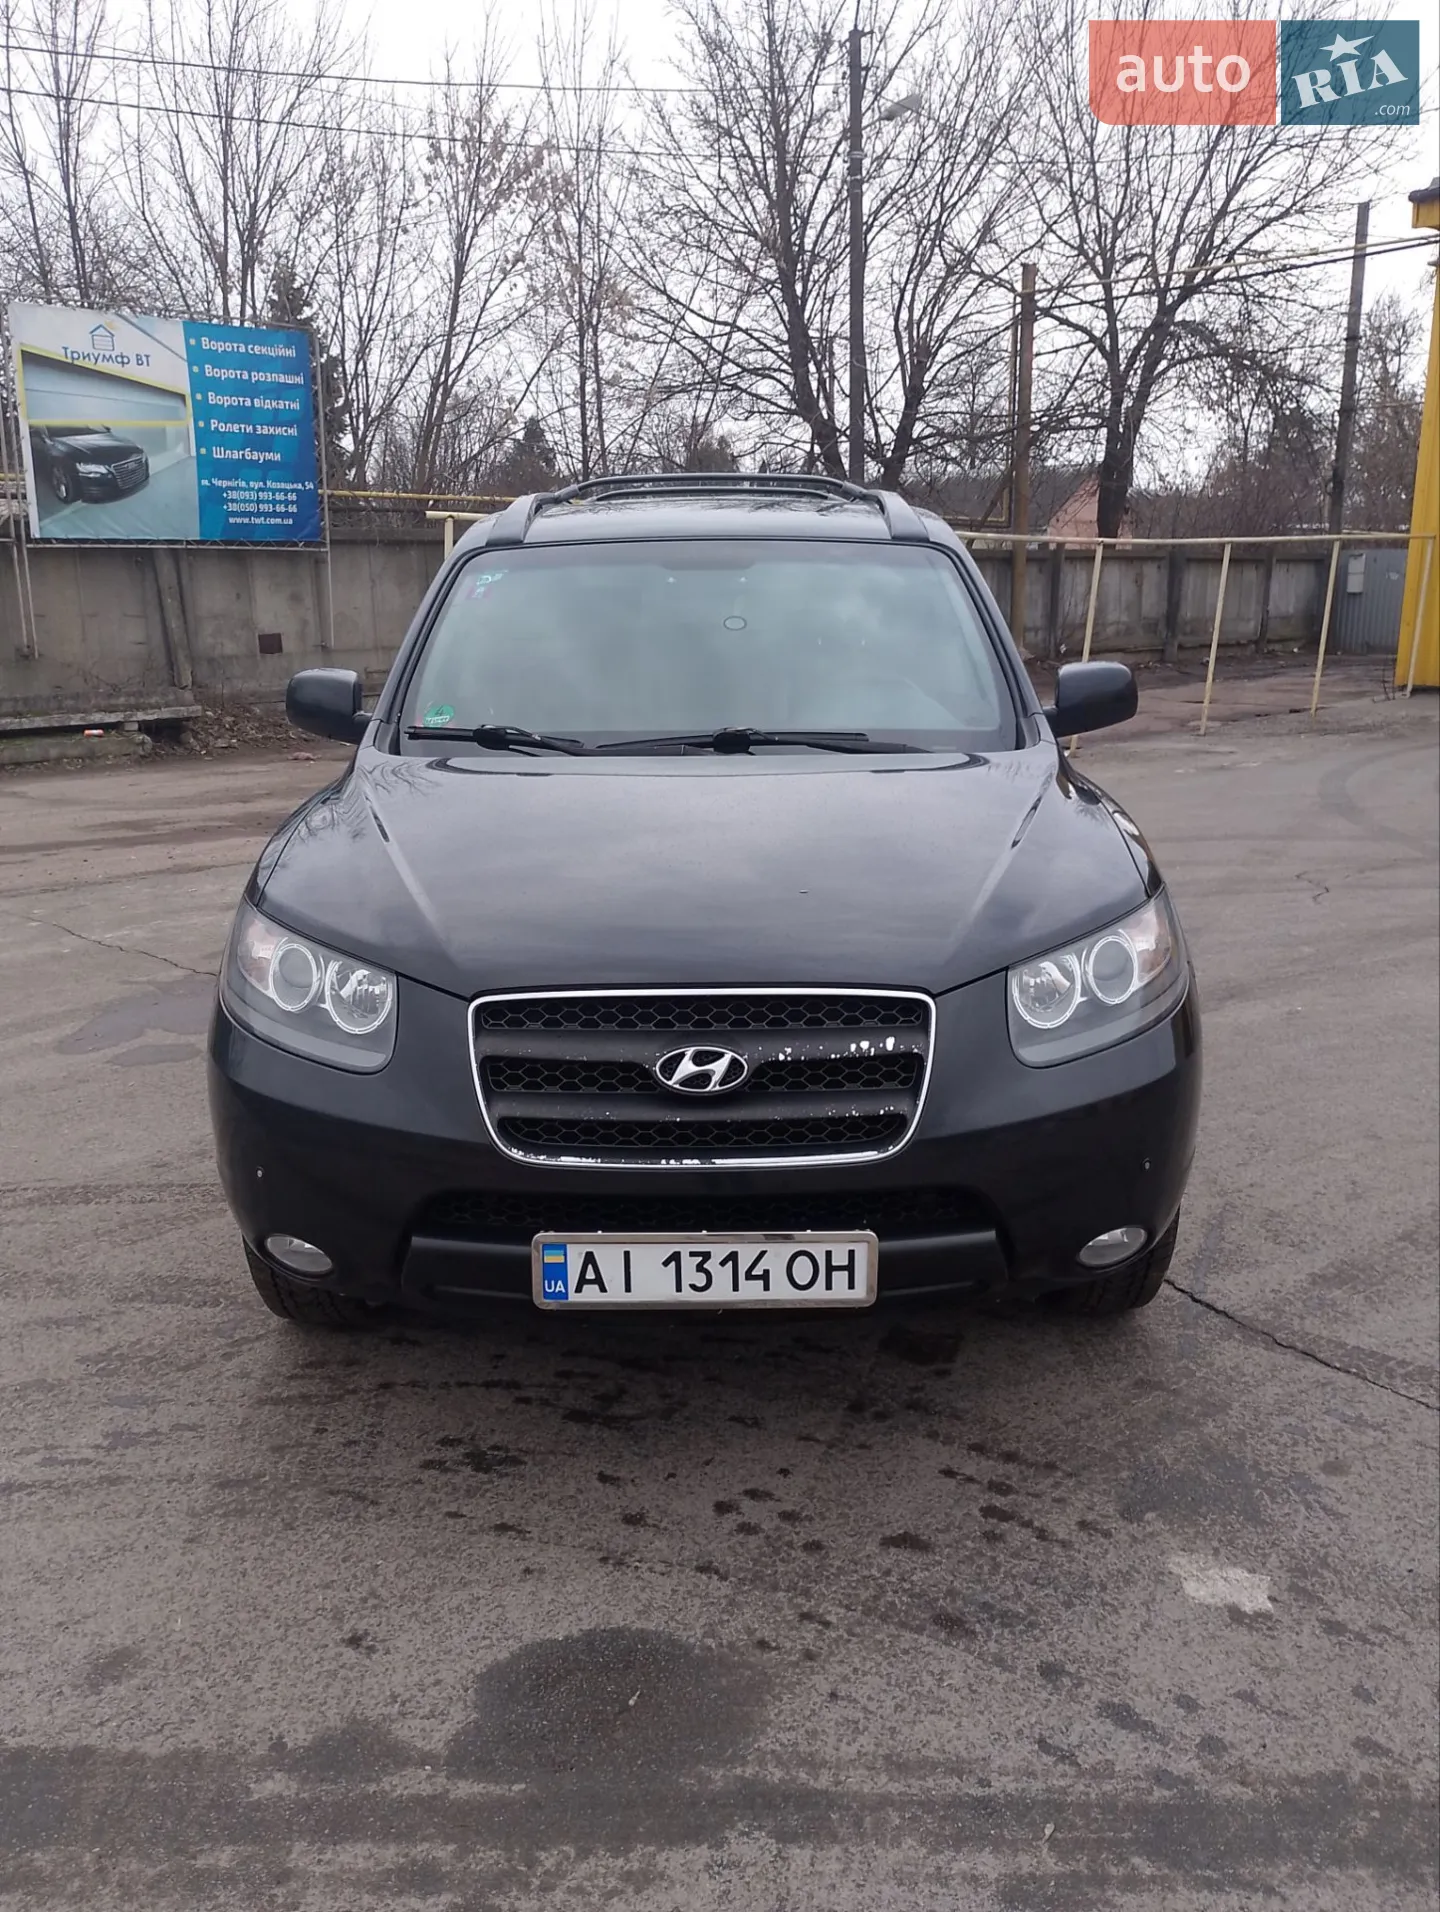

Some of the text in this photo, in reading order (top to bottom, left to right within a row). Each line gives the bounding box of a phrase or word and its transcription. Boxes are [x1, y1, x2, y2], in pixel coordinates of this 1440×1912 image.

[201, 337, 296, 358] Ворота секційні
[61, 346, 151, 368] Триумф ВТ
[204, 364, 304, 385] Ворота розпашні
[207, 391, 300, 410] Ворота відкатні
[210, 419, 298, 436] Ролети захисні
[212, 446, 281, 463] Шлагбауми
[222, 490, 297, 501] +38(093) 993-66-66
[222, 502, 297, 513] +38(050) 993-66-66
[574, 1249, 856, 1293] AI 1314 OH
[544, 1279, 566, 1293] UA
